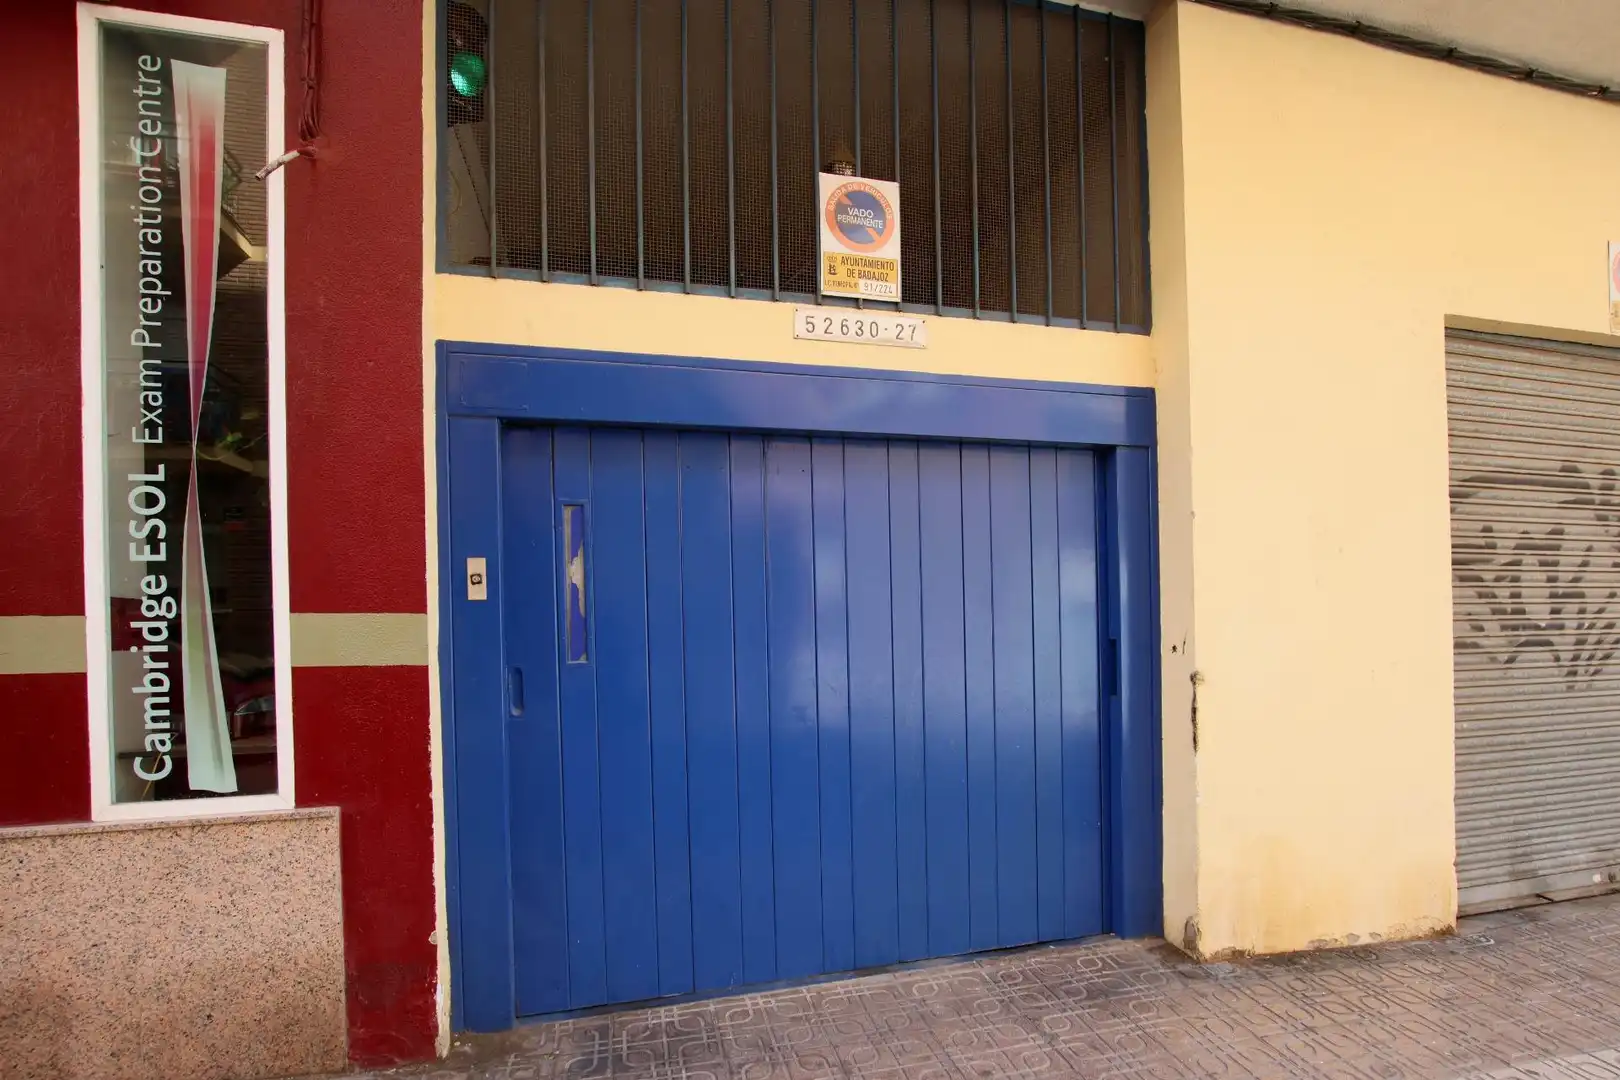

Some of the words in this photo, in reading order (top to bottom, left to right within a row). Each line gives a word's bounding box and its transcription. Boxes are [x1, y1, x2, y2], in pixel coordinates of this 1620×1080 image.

[129, 54, 162, 157] Centre
[827, 187, 847, 211] SALIDA
[837, 214, 884, 229] PERMANENTE
[847, 207, 874, 219] VADO
[130, 167, 172, 347] Preparation
[840, 256, 895, 271] AYUNTAMIENTO
[846, 268, 856, 278] DE
[857, 269, 889, 282] BADAJOZ
[131, 359, 163, 444] Exam
[127, 463, 167, 562] ESOL
[129, 574, 177, 782] Cambridge
